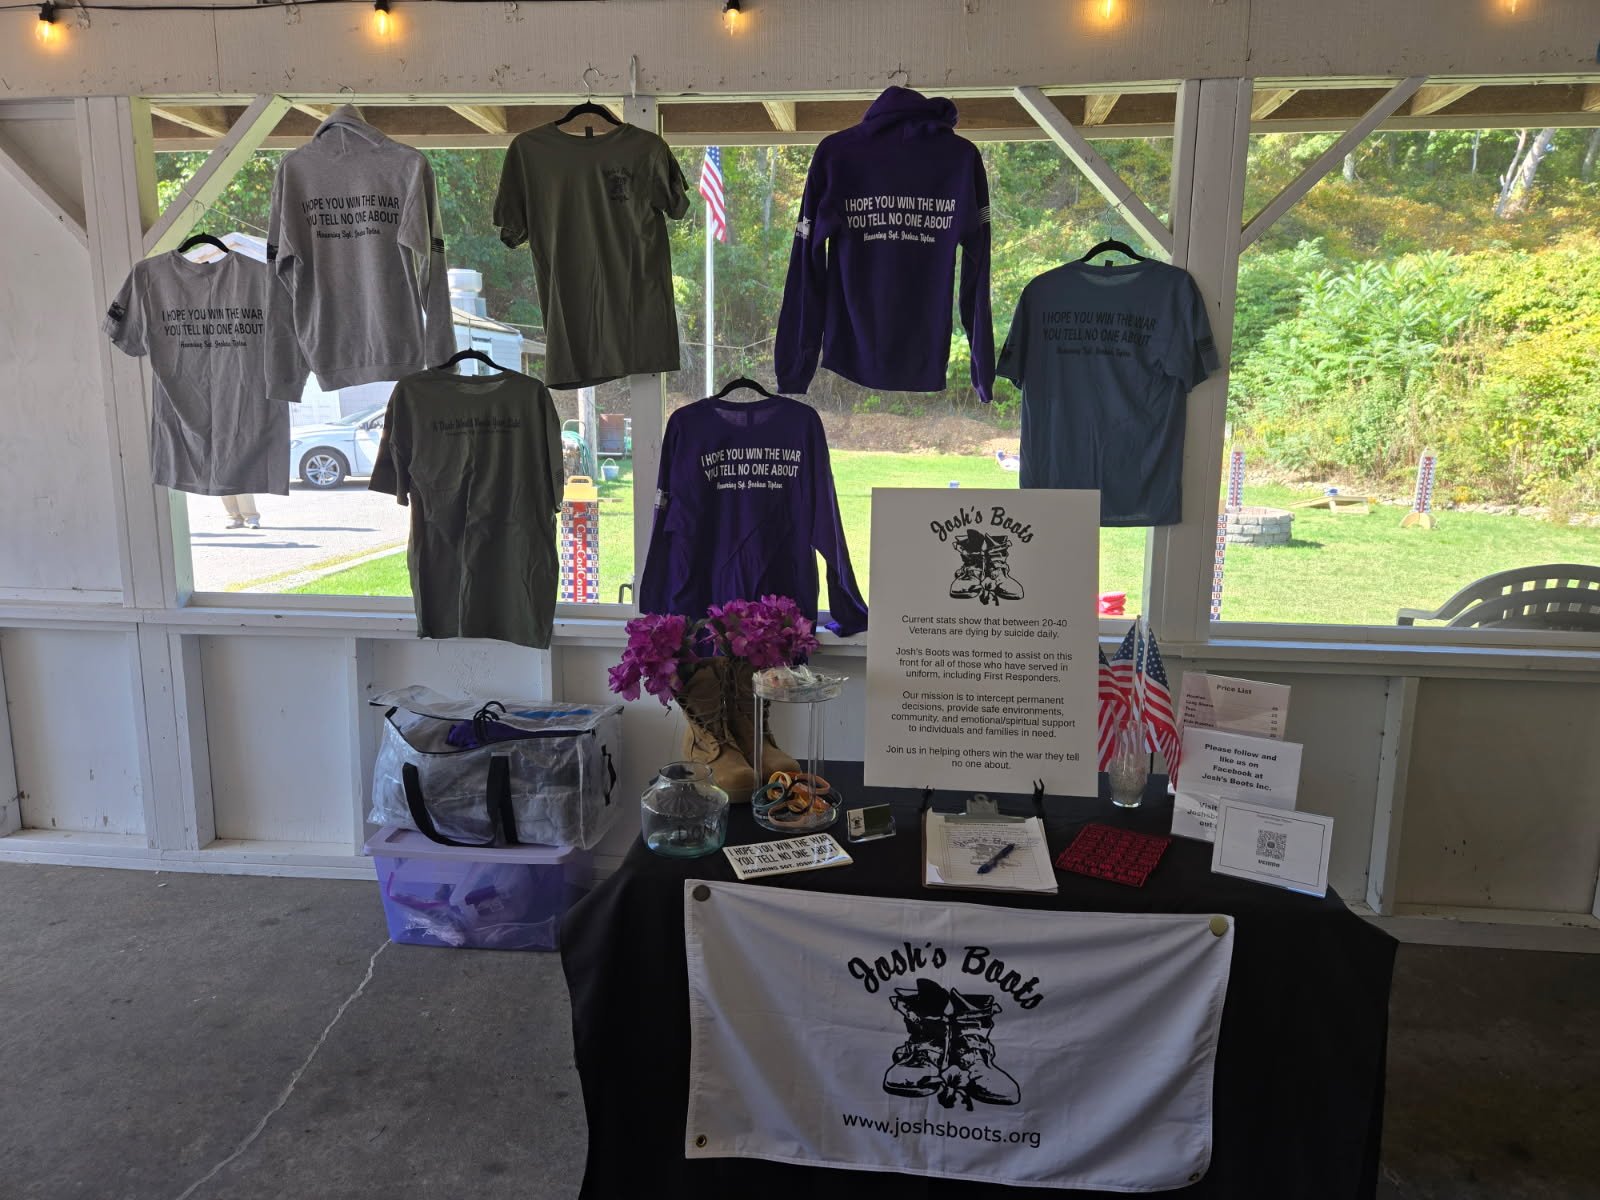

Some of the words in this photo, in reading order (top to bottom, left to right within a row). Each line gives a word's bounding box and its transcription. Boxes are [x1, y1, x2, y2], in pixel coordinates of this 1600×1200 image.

[302, 202, 306, 213] I
[326, 198, 344, 209] YOU
[346, 197, 360, 208] WIN
[362, 195, 375, 206] THE
[378, 196, 399, 209] WAR
[846, 200, 848, 211] I
[850, 198, 873, 211] HOPE
[875, 196, 894, 208] YOU
[897, 196, 915, 209] WIN
[917, 198, 933, 211] THE
[935, 199, 955, 212] WAR
[319, 214, 339, 225] TELL
[341, 214, 353, 224] NO
[368, 211, 399, 224] ABOUT
[847, 215, 866, 228] YOU
[868, 213, 886, 226] TELL
[889, 213, 902, 225] NO
[905, 213, 922, 227] ONE
[924, 216, 953, 229] ABOUT
[162, 311, 165, 321] I
[167, 310, 185, 320] HOPE
[188, 309, 205, 320] YOU
[208, 309, 224, 319] WIN
[225, 308, 239, 319] THE
[241, 309, 263, 319] WAR
[1043, 312, 1045, 324] I
[1048, 312, 1071, 324] HOPE
[1074, 312, 1093, 324] YOU
[1096, 312, 1115, 325] WIN
[1116, 313, 1132, 327] THE
[164, 325, 180, 336] YOU
[182, 325, 200, 335] TELL
[203, 324, 214, 335] NO
[217, 324, 232, 334] ONE
[235, 324, 263, 334] ABOUT
[1043, 328, 1062, 340] YOU
[1064, 329, 1082, 340] TELL
[1085, 328, 1098, 340] NO
[1101, 329, 1120, 342] ONE
[701, 456, 705, 467] I
[705, 450, 724, 465] HOPE
[726, 448, 744, 460] YOU
[746, 448, 762, 459] WIN
[765, 448, 780, 460] THE
[782, 449, 801, 462] WAR
[720, 465, 736, 476] TELL
[738, 464, 749, 475] NO
[752, 464, 769, 475] ONE
[771, 465, 798, 477] ABOUT
[930, 506, 983, 542] Josh's
[991, 507, 1034, 543] Boots
[902, 616, 933, 624] Current
[959, 617, 981, 625] show
[984, 618, 1000, 626] that
[1003, 618, 1039, 626] between
[1042, 619, 1067, 627] 20-40
[909, 626, 947, 635] Veterans
[966, 628, 988, 638] dying
[992, 628, 1001, 637] by
[1004, 629, 1035, 638] suicide
[1037, 629, 1059, 639] daily.
[896, 648, 922, 656] Josh's
[925, 649, 950, 657] Boots
[972, 650, 1002, 658] formed
[1005, 651, 1013, 659] to
[1016, 651, 1040, 660] assist
[1057, 652, 1072, 661] this
[899, 659, 918, 667] front
[921, 659, 932, 667] for
[958, 660, 981, 668] those
[984, 661, 1002, 669] who
[1005, 661, 1025, 670] have
[1028, 662, 1058, 671] served
[1060, 663, 1068, 672] in
[906, 670, 940, 679] uniform,
[944, 671, 981, 681] including
[984, 672, 1003, 680] First
[903, 691, 918, 699] Our
[921, 692, 953, 700] mission
[957, 693, 963, 701] is
[977, 695, 1014, 703] intercept
[1017, 696, 1064, 705] permanent
[902, 702, 944, 712] decisions,
[947, 704, 978, 713] provide
[1003, 706, 1063, 716] environments,
[891, 713, 939, 723] community,
[942, 714, 958, 722] and
[961, 716, 1039, 726] emotional/spiritual
[1042, 719, 1075, 728] support
[920, 725, 964, 734] individuals
[967, 727, 982, 735] and
[985, 727, 1018, 736] families
[1022, 729, 1029, 737] in
[1032, 729, 1056, 738] need.
[887, 745, 903, 753] Join
[919, 746, 926, 754] in
[930, 747, 960, 757] helping
[963, 749, 990, 757] others
[993, 750, 1007, 758] win
[1010, 750, 1023, 759] the
[1026, 752, 1042, 760] war
[1045, 752, 1064, 762] they
[1067, 753, 1079, 761] tell
[1205, 744, 1231, 753] Please
[1234, 749, 1258, 758] follow
[985, 760, 1011, 769] about.
[1220, 756, 1234, 764] like
[1213, 765, 1252, 777] Facebook
[1202, 773, 1227, 783] Josh's
[1230, 778, 1253, 788] Boots
[1256, 782, 1271, 791] Inc.
[1200, 802, 1218, 811] Visit
[1187, 809, 1218, 819] Joshsb
[734, 847, 755, 856] HOPE
[756, 844, 773, 853] YOU
[774, 841, 792, 850] WIN
[792, 839, 809, 848] THE
[810, 835, 831, 845] WAR
[734, 856, 754, 866] YOU
[757, 853, 778, 864] TELL
[778, 851, 792, 861] NO
[793, 849, 810, 859] ONE
[743, 866, 778, 874] HONORING
[848, 942, 946, 993] Josh's
[961, 946, 1043, 1009] Boots
[842, 1113, 1040, 1148] www.joshsboots.org
